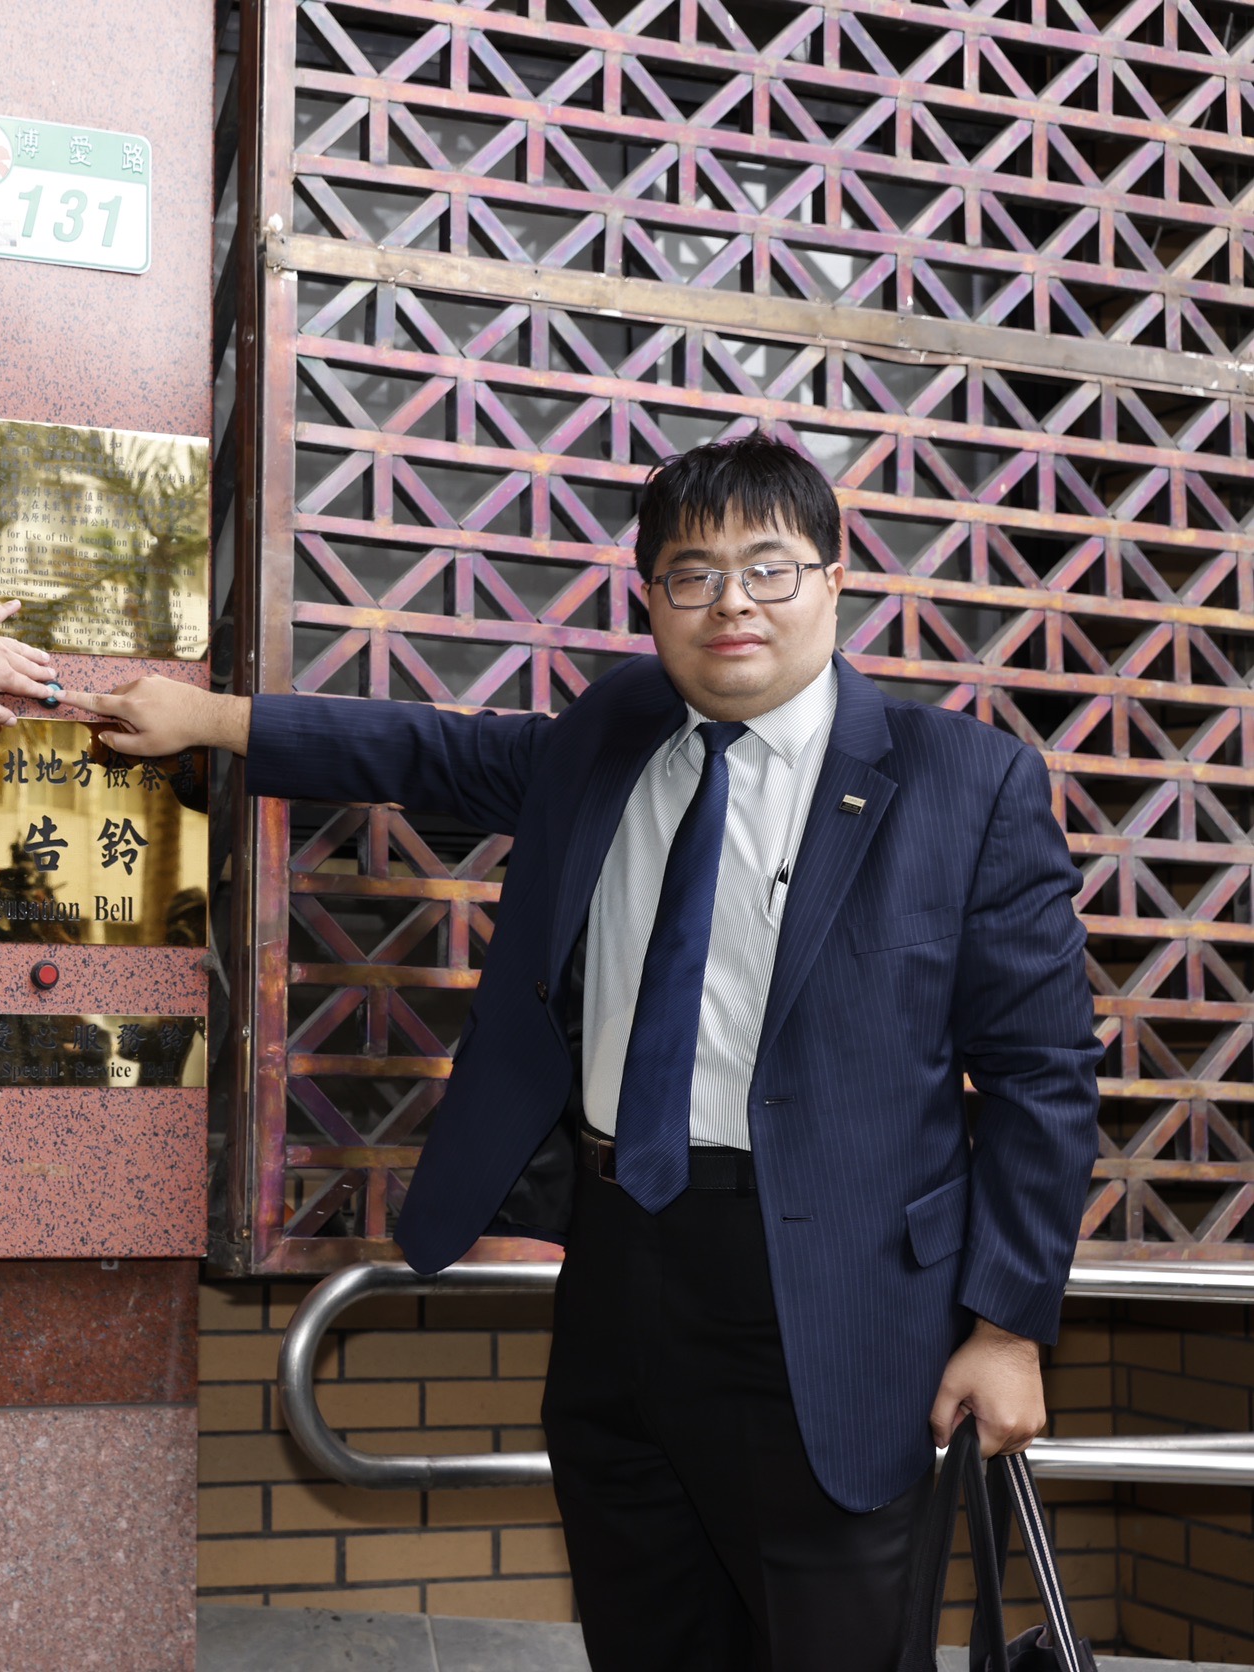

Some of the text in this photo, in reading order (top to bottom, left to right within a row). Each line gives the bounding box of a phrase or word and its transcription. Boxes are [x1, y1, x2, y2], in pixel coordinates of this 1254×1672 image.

[15, 126, 145, 174] 博愛路
[17, 185, 123, 248] 131
[7, 529, 20, 539] for
[26, 530, 41, 541] Use
[46, 532, 56, 542] of
[59, 533, 74, 544] the
[7, 543, 33, 553] photo
[37, 545, 47, 554] ID
[52, 547, 61, 555] to
[10, 556, 43, 566] provide
[33, 567, 49, 576] and
[38, 592, 48, 600] or
[111, 585, 119, 593] to
[172, 589, 180, 597] to
[70, 615, 83, 624] not
[88, 615, 110, 625] leave
[170, 611, 183, 620] the
[74, 627, 92, 637] only
[97, 627, 107, 636] be
[50, 636, 71, 645] our
[76, 637, 83, 645] is
[87, 638, 108, 647] from
[93, 895, 134, 923] Bell
[1, 1061, 60, 1082] Special
[75, 1061, 132, 1079] Service
